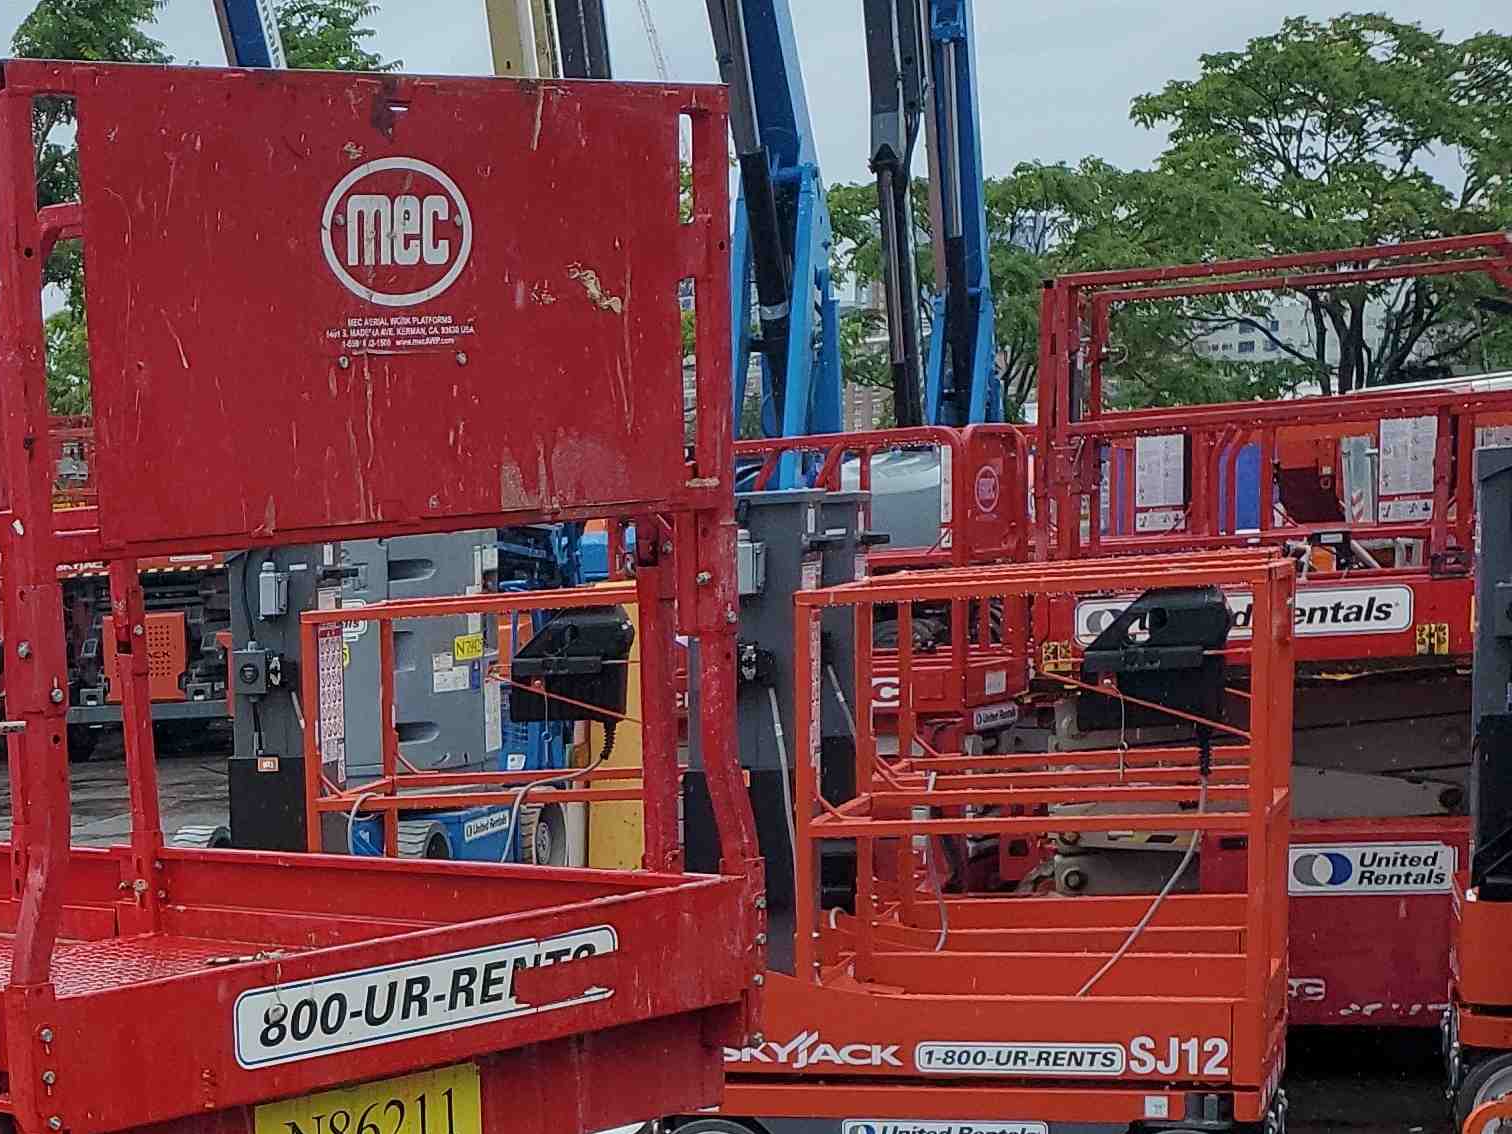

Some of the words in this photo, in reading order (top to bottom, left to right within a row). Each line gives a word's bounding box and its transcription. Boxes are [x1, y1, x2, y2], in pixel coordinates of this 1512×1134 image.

[1359, 851, 1438, 868] United
[1358, 870, 1446, 886] Rentals
[922, 1048, 1118, 1070] 1-800-UR-RENTS
[1128, 1035, 1230, 1077] SJ12
